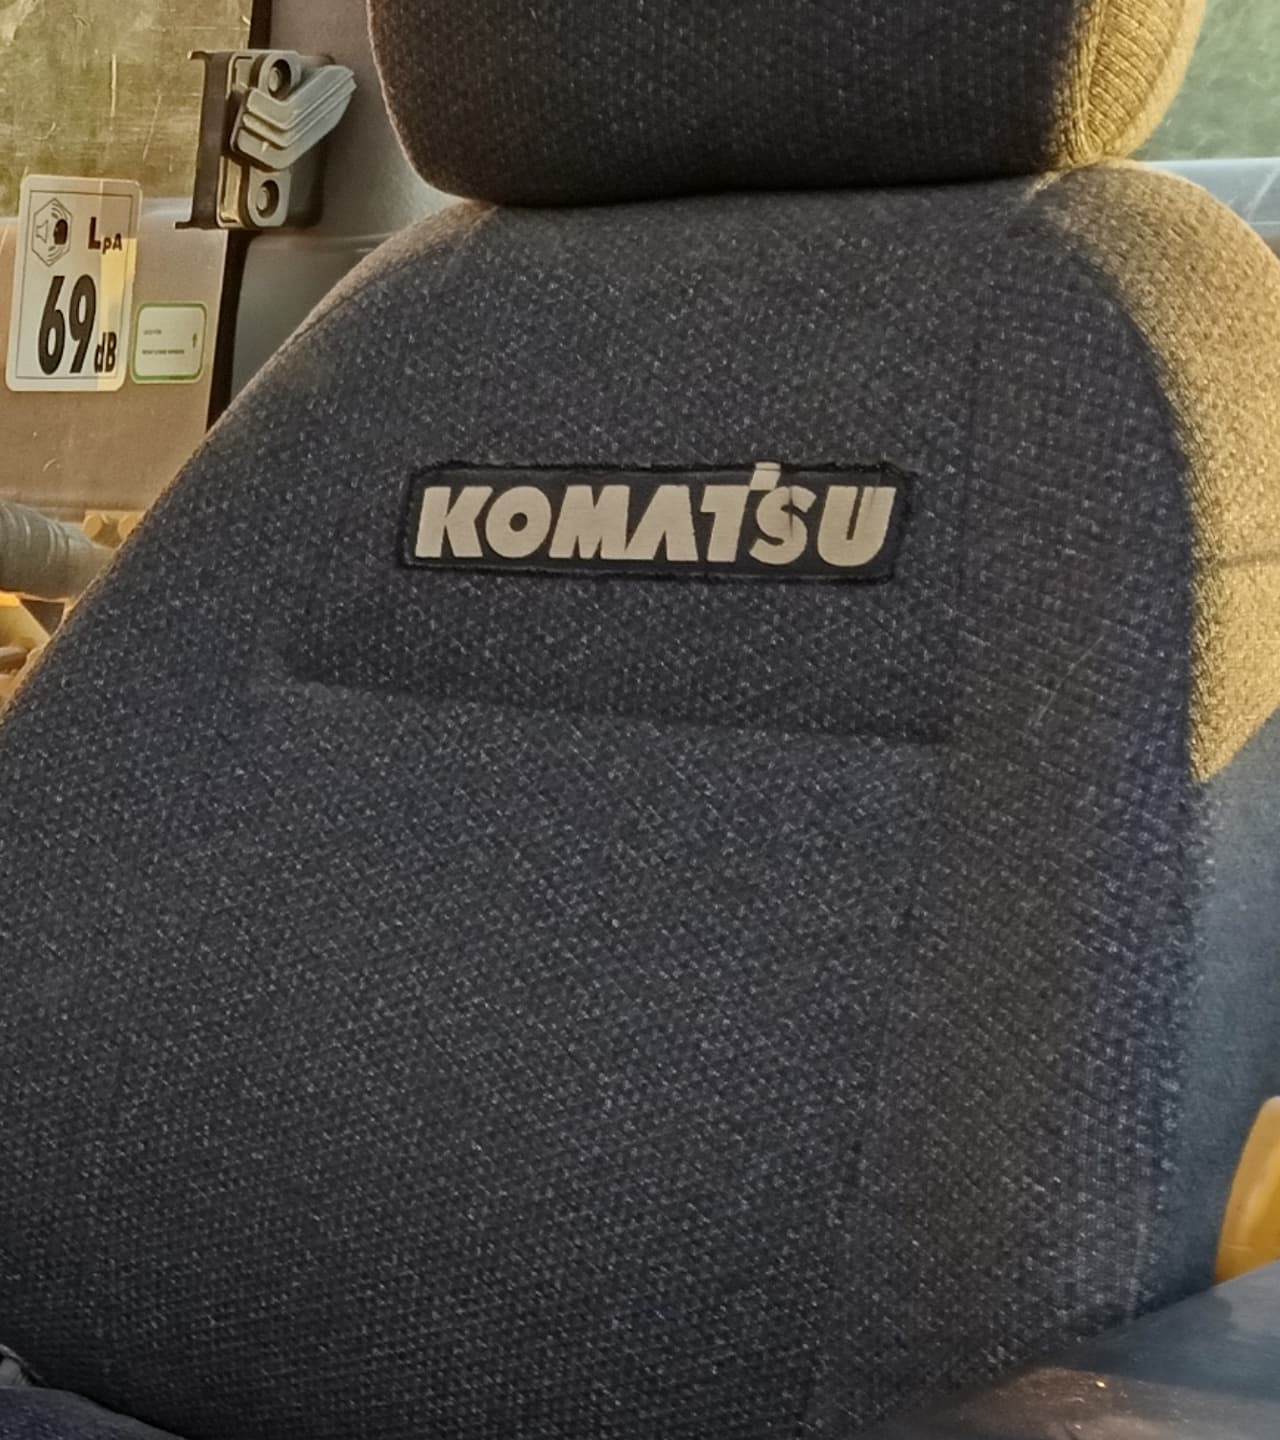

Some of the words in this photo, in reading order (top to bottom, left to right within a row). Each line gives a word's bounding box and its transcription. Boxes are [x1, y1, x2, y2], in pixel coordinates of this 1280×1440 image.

[38, 274, 97, 375] 69
[94, 332, 118, 373] dB
[415, 463, 897, 567] KOMATSU
